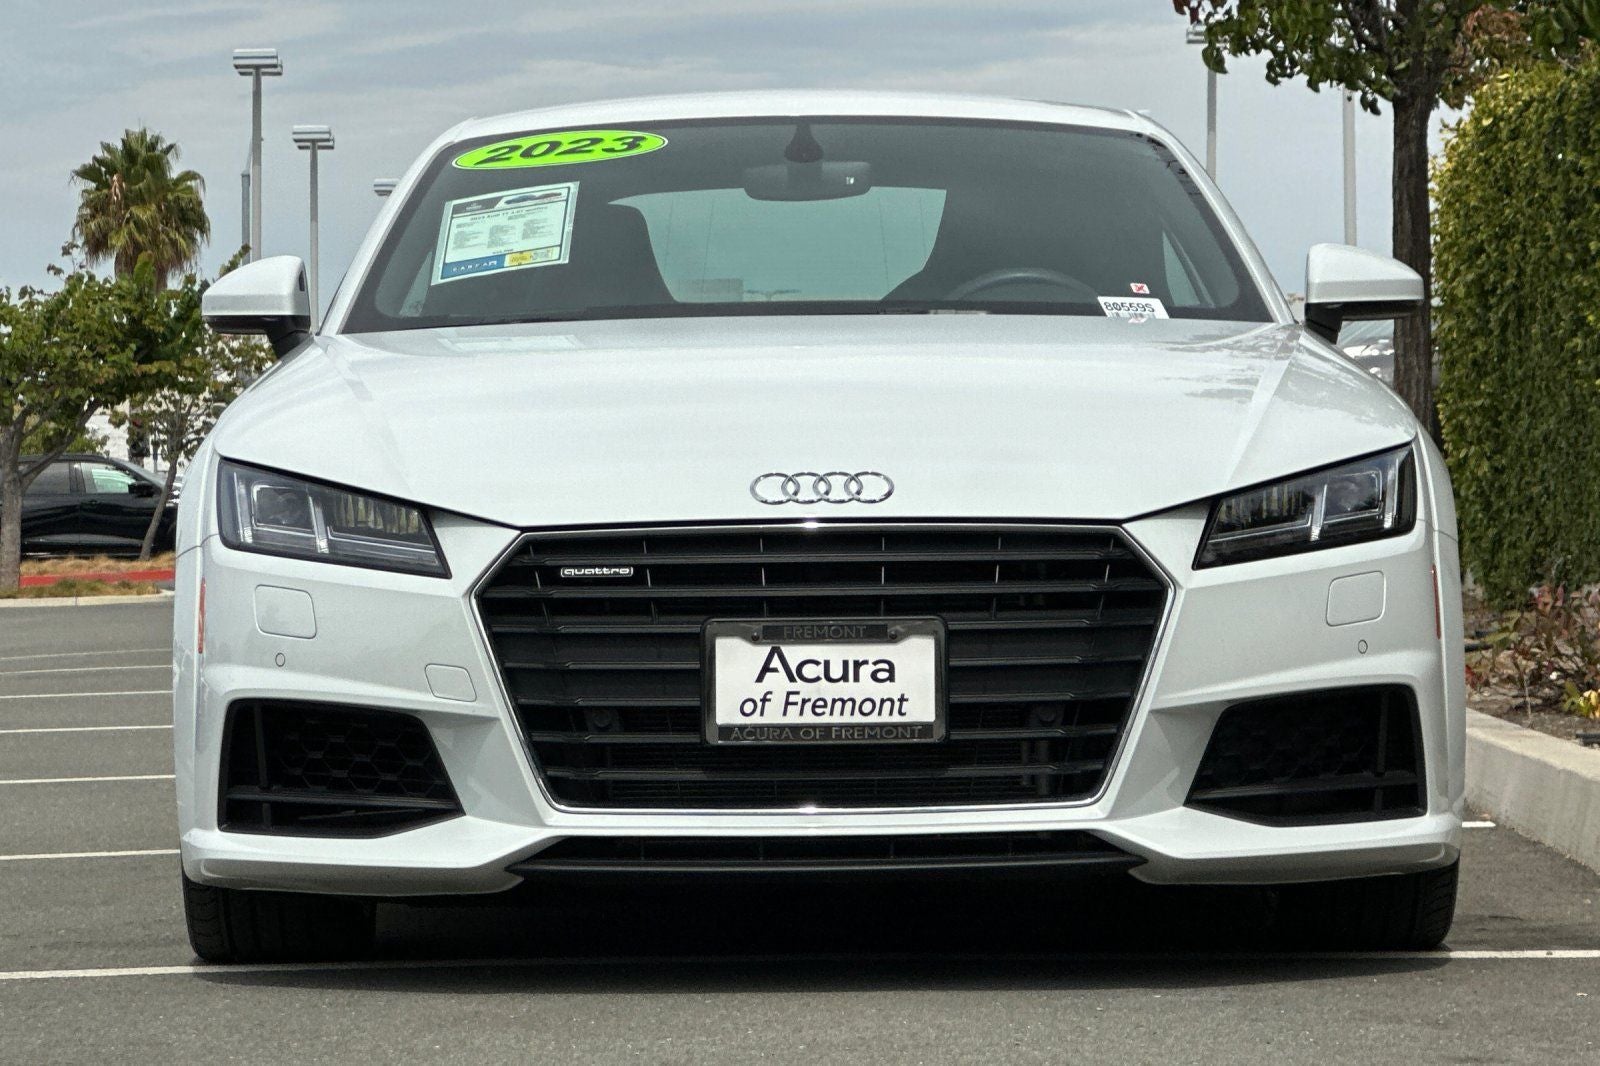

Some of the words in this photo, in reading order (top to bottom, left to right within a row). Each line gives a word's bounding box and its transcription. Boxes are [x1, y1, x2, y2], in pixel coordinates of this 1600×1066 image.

[474, 135, 648, 166] 2023
[563, 567, 630, 576] quattro
[783, 625, 867, 639] FREMONT
[755, 646, 896, 683] Acura
[739, 691, 773, 717] of
[782, 690, 909, 717] Fremont
[730, 727, 795, 740] ACURA
[800, 727, 825, 740] OF
[831, 725, 923, 739] FREMONT
